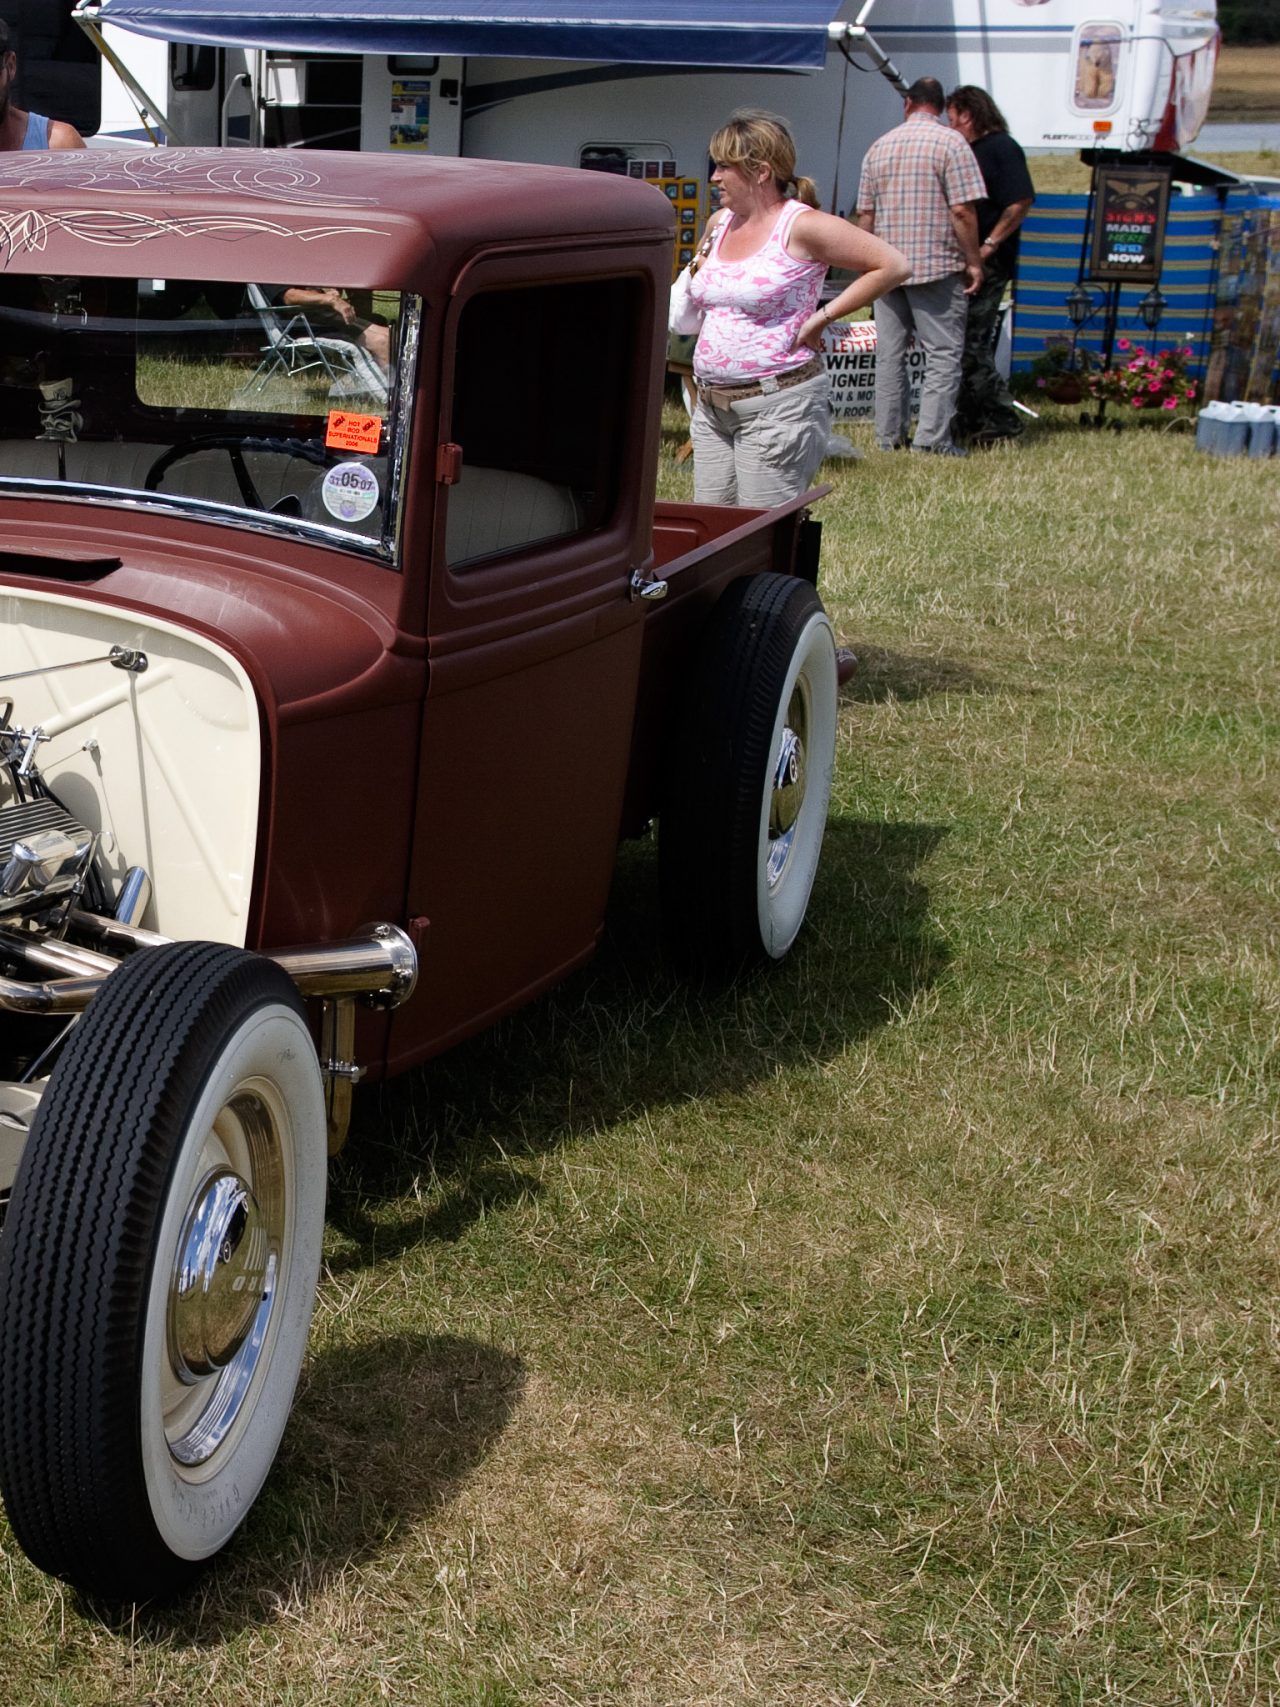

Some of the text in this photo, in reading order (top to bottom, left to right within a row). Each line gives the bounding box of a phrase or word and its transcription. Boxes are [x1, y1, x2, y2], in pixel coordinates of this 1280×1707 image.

[1106, 223, 1152, 233] MADE
[1108, 233, 1147, 243] HERE
[1108, 253, 1145, 263] NOW
[844, 406, 872, 417] ROOF
[341, 472, 360, 488] 05
[360, 480, 374, 491] 07
